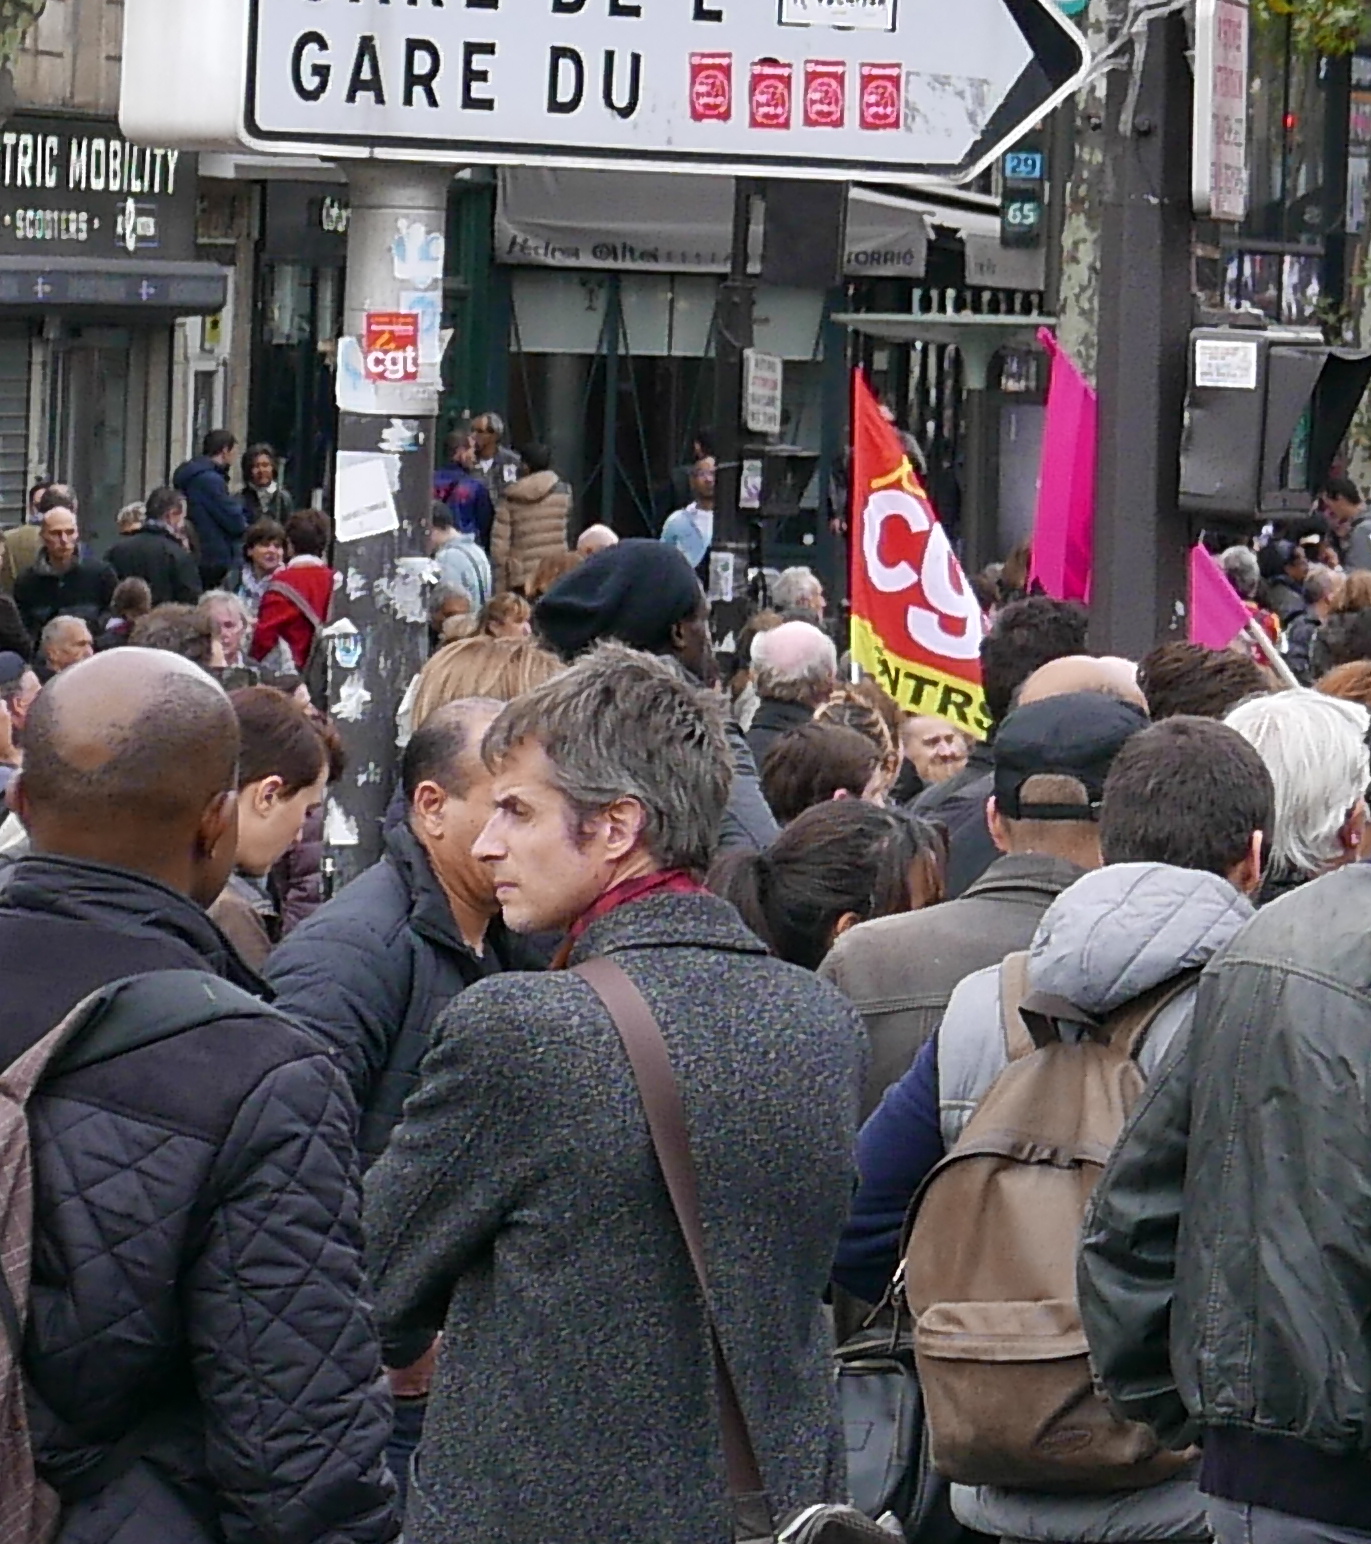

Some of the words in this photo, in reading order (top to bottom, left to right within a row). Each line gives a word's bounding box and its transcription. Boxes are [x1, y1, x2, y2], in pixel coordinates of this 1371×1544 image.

[290, 30, 496, 112] GARE
[545, 45, 642, 120] DU
[68, 135, 179, 195] MOBILITY
[1009, 155, 1037, 175] 29
[1007, 201, 1036, 225] 65
[366, 345, 418, 379] cgt
